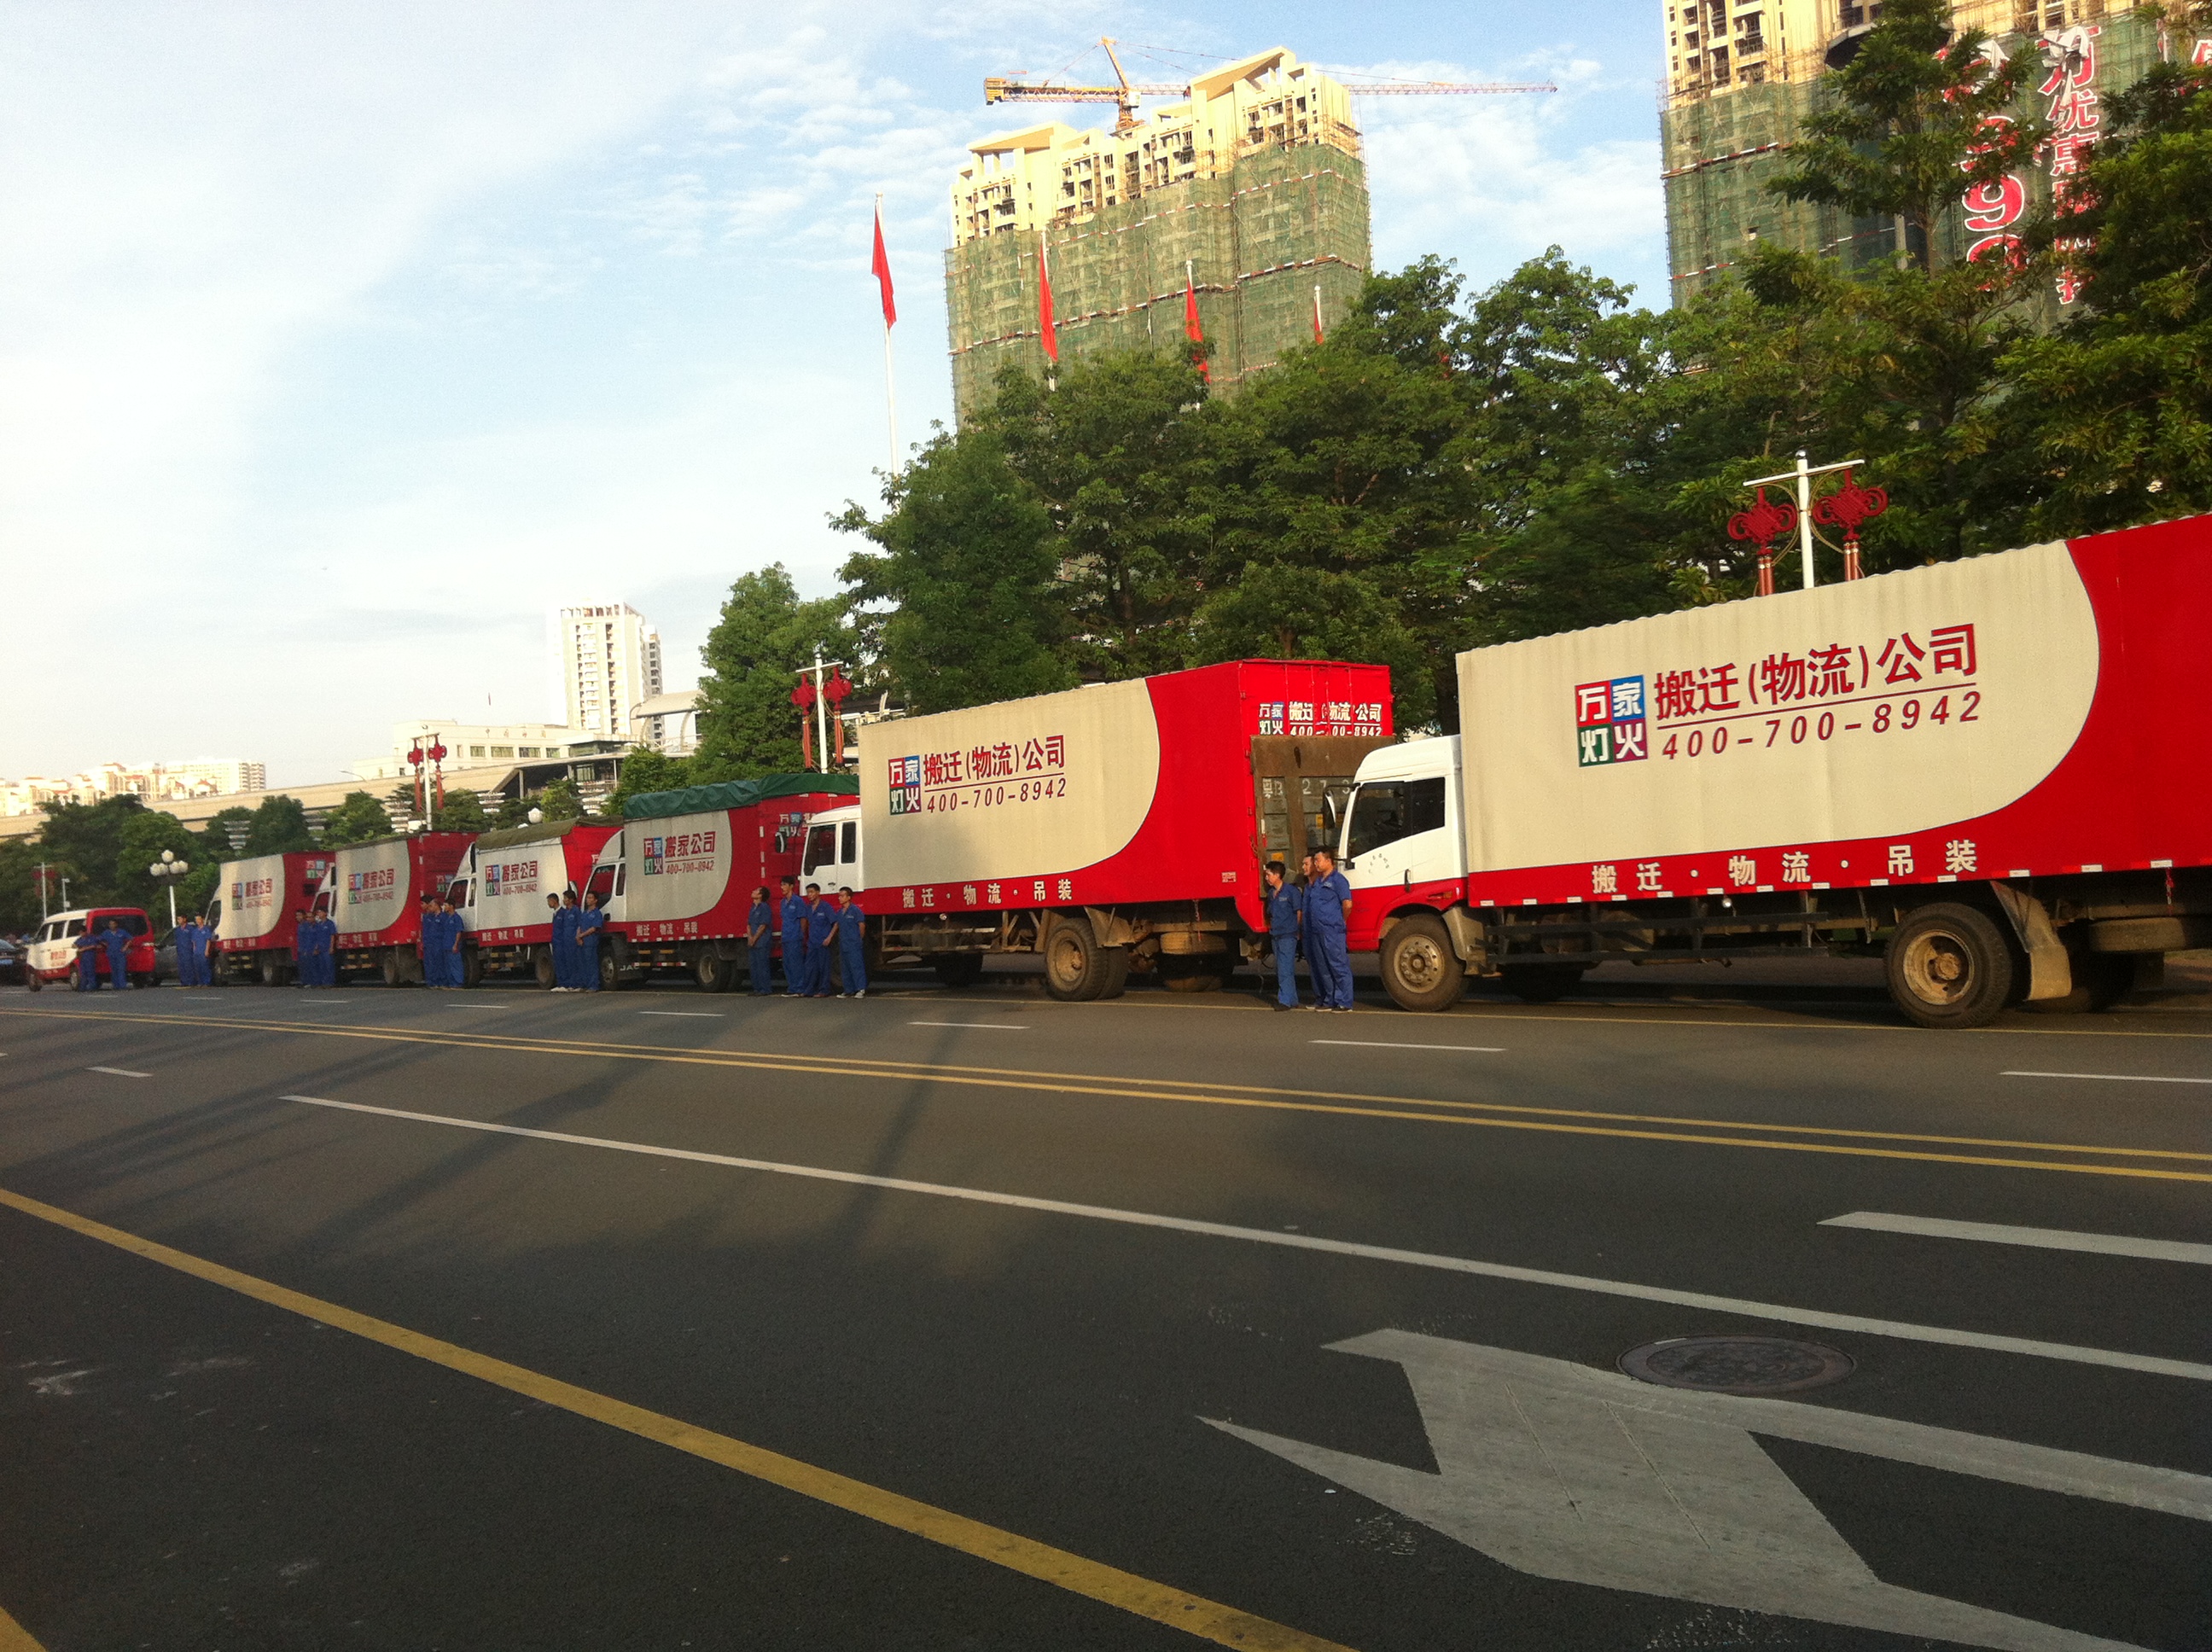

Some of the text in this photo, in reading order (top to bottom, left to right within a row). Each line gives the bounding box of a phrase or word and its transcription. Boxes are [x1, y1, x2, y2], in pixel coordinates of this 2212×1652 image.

[1654, 624, 1977, 720] 搬迁(物流)公司
[1259, 702, 1284, 718] 万家
[1578, 680, 1644, 723] 万家
[1259, 720, 1284, 735] 灯火
[1289, 725, 1382, 736] 400-00-8942
[1662, 690, 1981, 760] 400-700-8942
[923, 735, 1065, 786] 搬迁(物流)公司
[1580, 724, 1646, 765] 灯火
[889, 759, 919, 785] 万家
[891, 787, 920, 813] 灯火
[928, 777, 1067, 813] 400-700-8942
